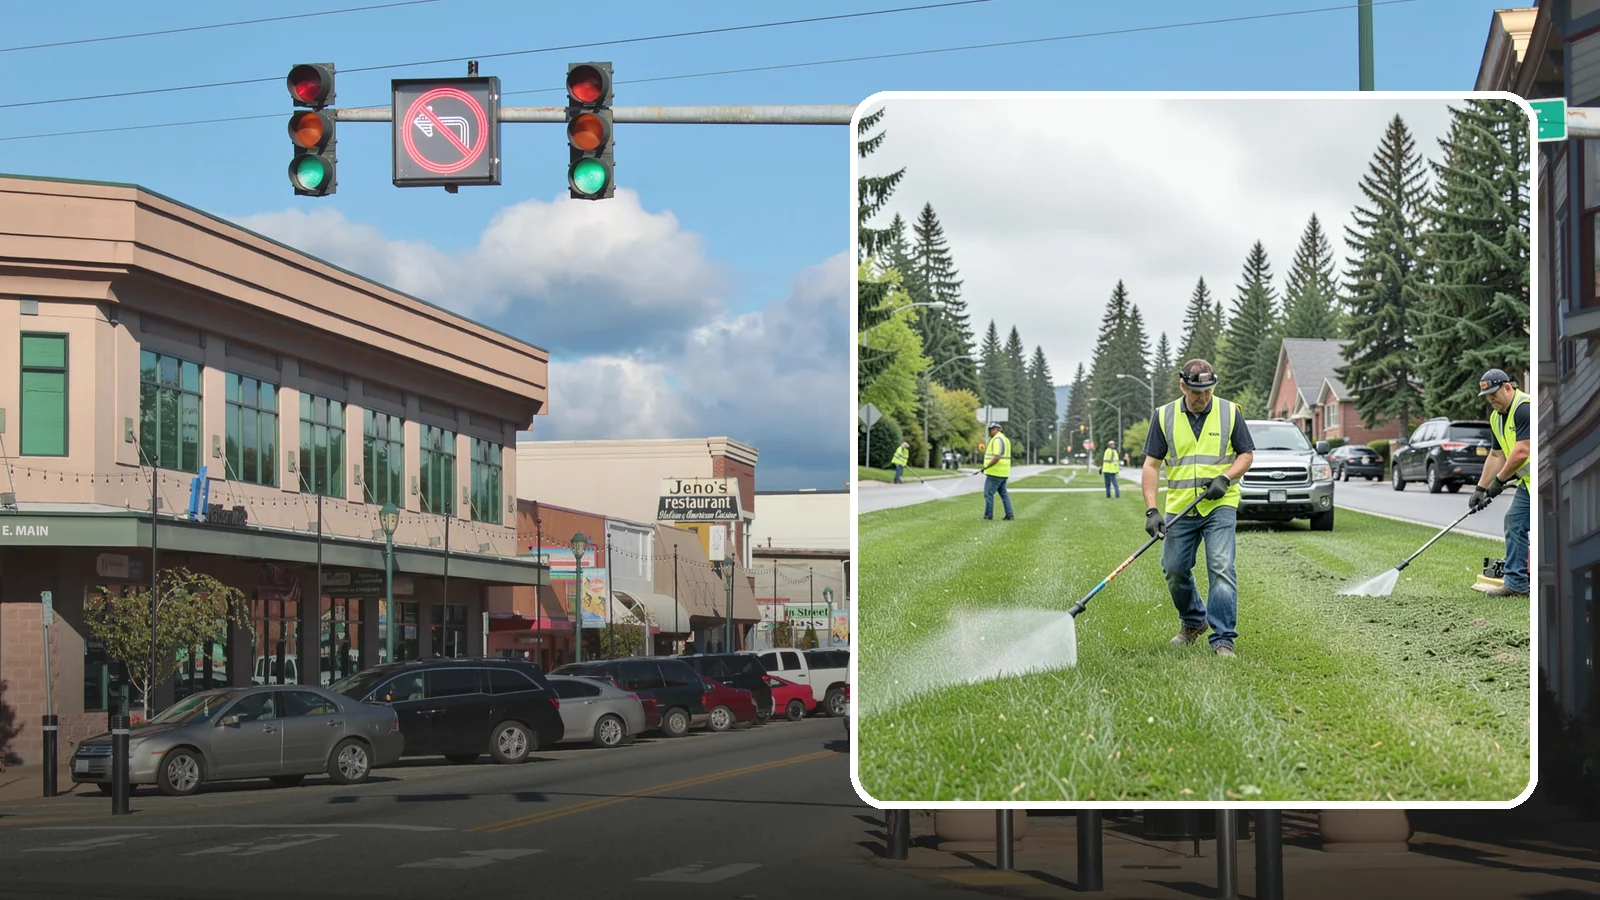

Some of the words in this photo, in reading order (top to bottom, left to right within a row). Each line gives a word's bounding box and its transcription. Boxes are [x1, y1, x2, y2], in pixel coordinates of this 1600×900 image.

[669, 480, 728, 495] Jeno's
[665, 496, 731, 509] restaurant
[658, 510, 682, 520] Italian
[686, 509, 714, 520] American
[714, 509, 738, 519] Cuisine
[2, 525, 13, 536] E.
[15, 525, 49, 536] MAIN
[797, 607, 828, 616] Street
[791, 619, 824, 627] lass
